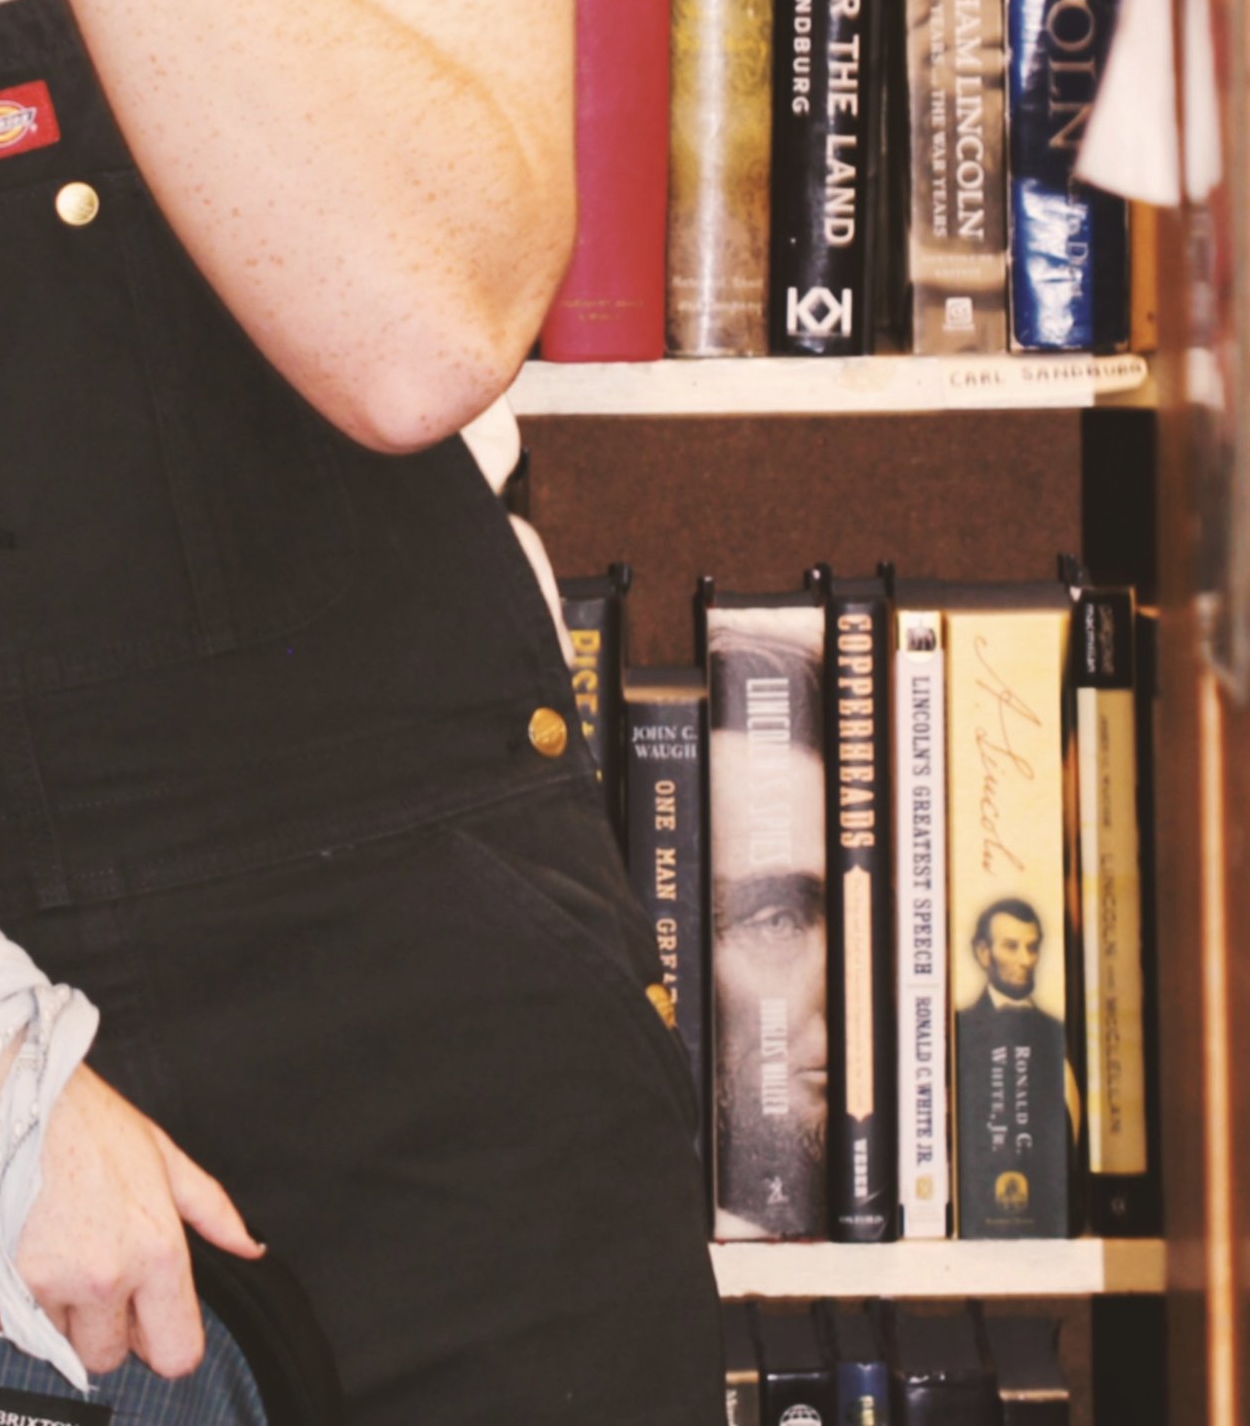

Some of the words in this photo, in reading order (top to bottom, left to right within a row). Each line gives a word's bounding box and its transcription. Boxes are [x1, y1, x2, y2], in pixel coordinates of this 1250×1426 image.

[929, 4, 946, 66] YEARS
[826, 34, 861, 117] THE
[931, 90, 948, 130] THE
[932, 134, 948, 174] WAR
[955, 75, 985, 241] LINCOLN
[823, 133, 858, 248] LAND
[932, 178, 948, 239] YEARS
[949, 371, 1006, 387] CARL
[1020, 361, 1144, 381] SANDBURG
[1085, 603, 1097, 674] macmillan
[632, 725, 677, 742] JOHN
[634, 743, 697, 759] WAUGH
[837, 614, 875, 848] COPPERHEADS
[912, 675, 932, 777] LINCOLN'S
[654, 779, 677, 832] ONE
[974, 727, 1035, 878] Lincoln
[912, 785, 932, 889] GREATEST
[655, 847, 677, 901] MAN
[1101, 852, 1117, 957] LINCOLN
[913, 898, 932, 975] SPEECH
[915, 996, 933, 1063] RONALD
[915, 1066, 933, 1080] C.
[1014, 1045, 1033, 1126] RONALD
[915, 1082, 933, 1139] WHITE
[987, 1124, 1009, 1153] JR.
[853, 1138, 869, 1198] WEBER
[915, 1143, 933, 1168] JR.
[1015, 1131, 1034, 1155] C.
